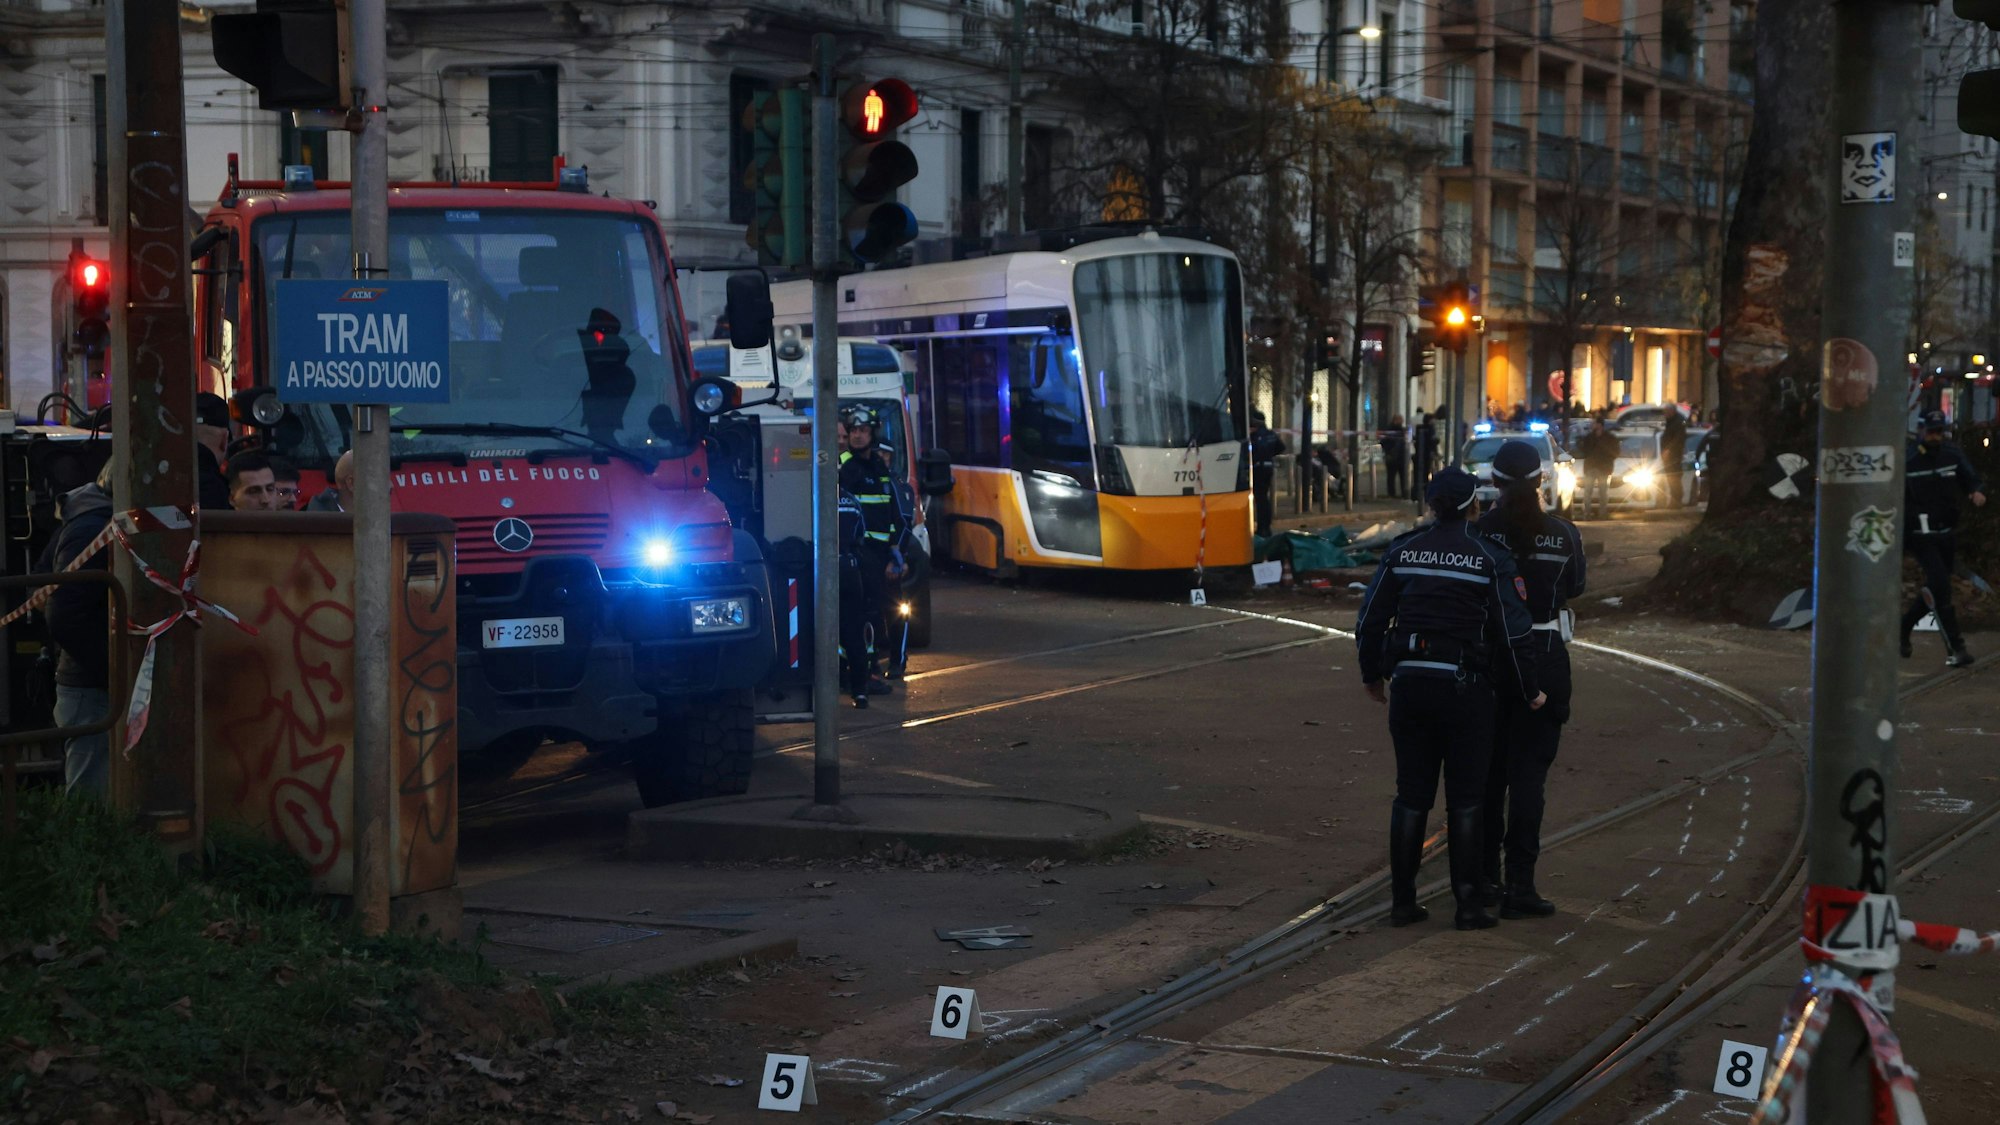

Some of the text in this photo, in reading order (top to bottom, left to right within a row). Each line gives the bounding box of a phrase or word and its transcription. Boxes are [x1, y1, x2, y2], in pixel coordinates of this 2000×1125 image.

[352, 290, 373, 299] ATM
[317, 313, 409, 354] TRAM
[286, 360, 441, 389] A PASSO D'UOMO
[469, 449, 527, 458] UNIMOG
[395, 467, 600, 487] VIGILI DEL FUOCO
[1535, 534, 1564, 549] CALE
[1400, 550, 1484, 570] POLIZIA LOCALE
[1195, 591, 1204, 602] A
[1817, 899, 1900, 949] IZIA
[941, 994, 963, 1028] 6
[1726, 1050, 1753, 1087] 8
[770, 1062, 797, 1100] 5
